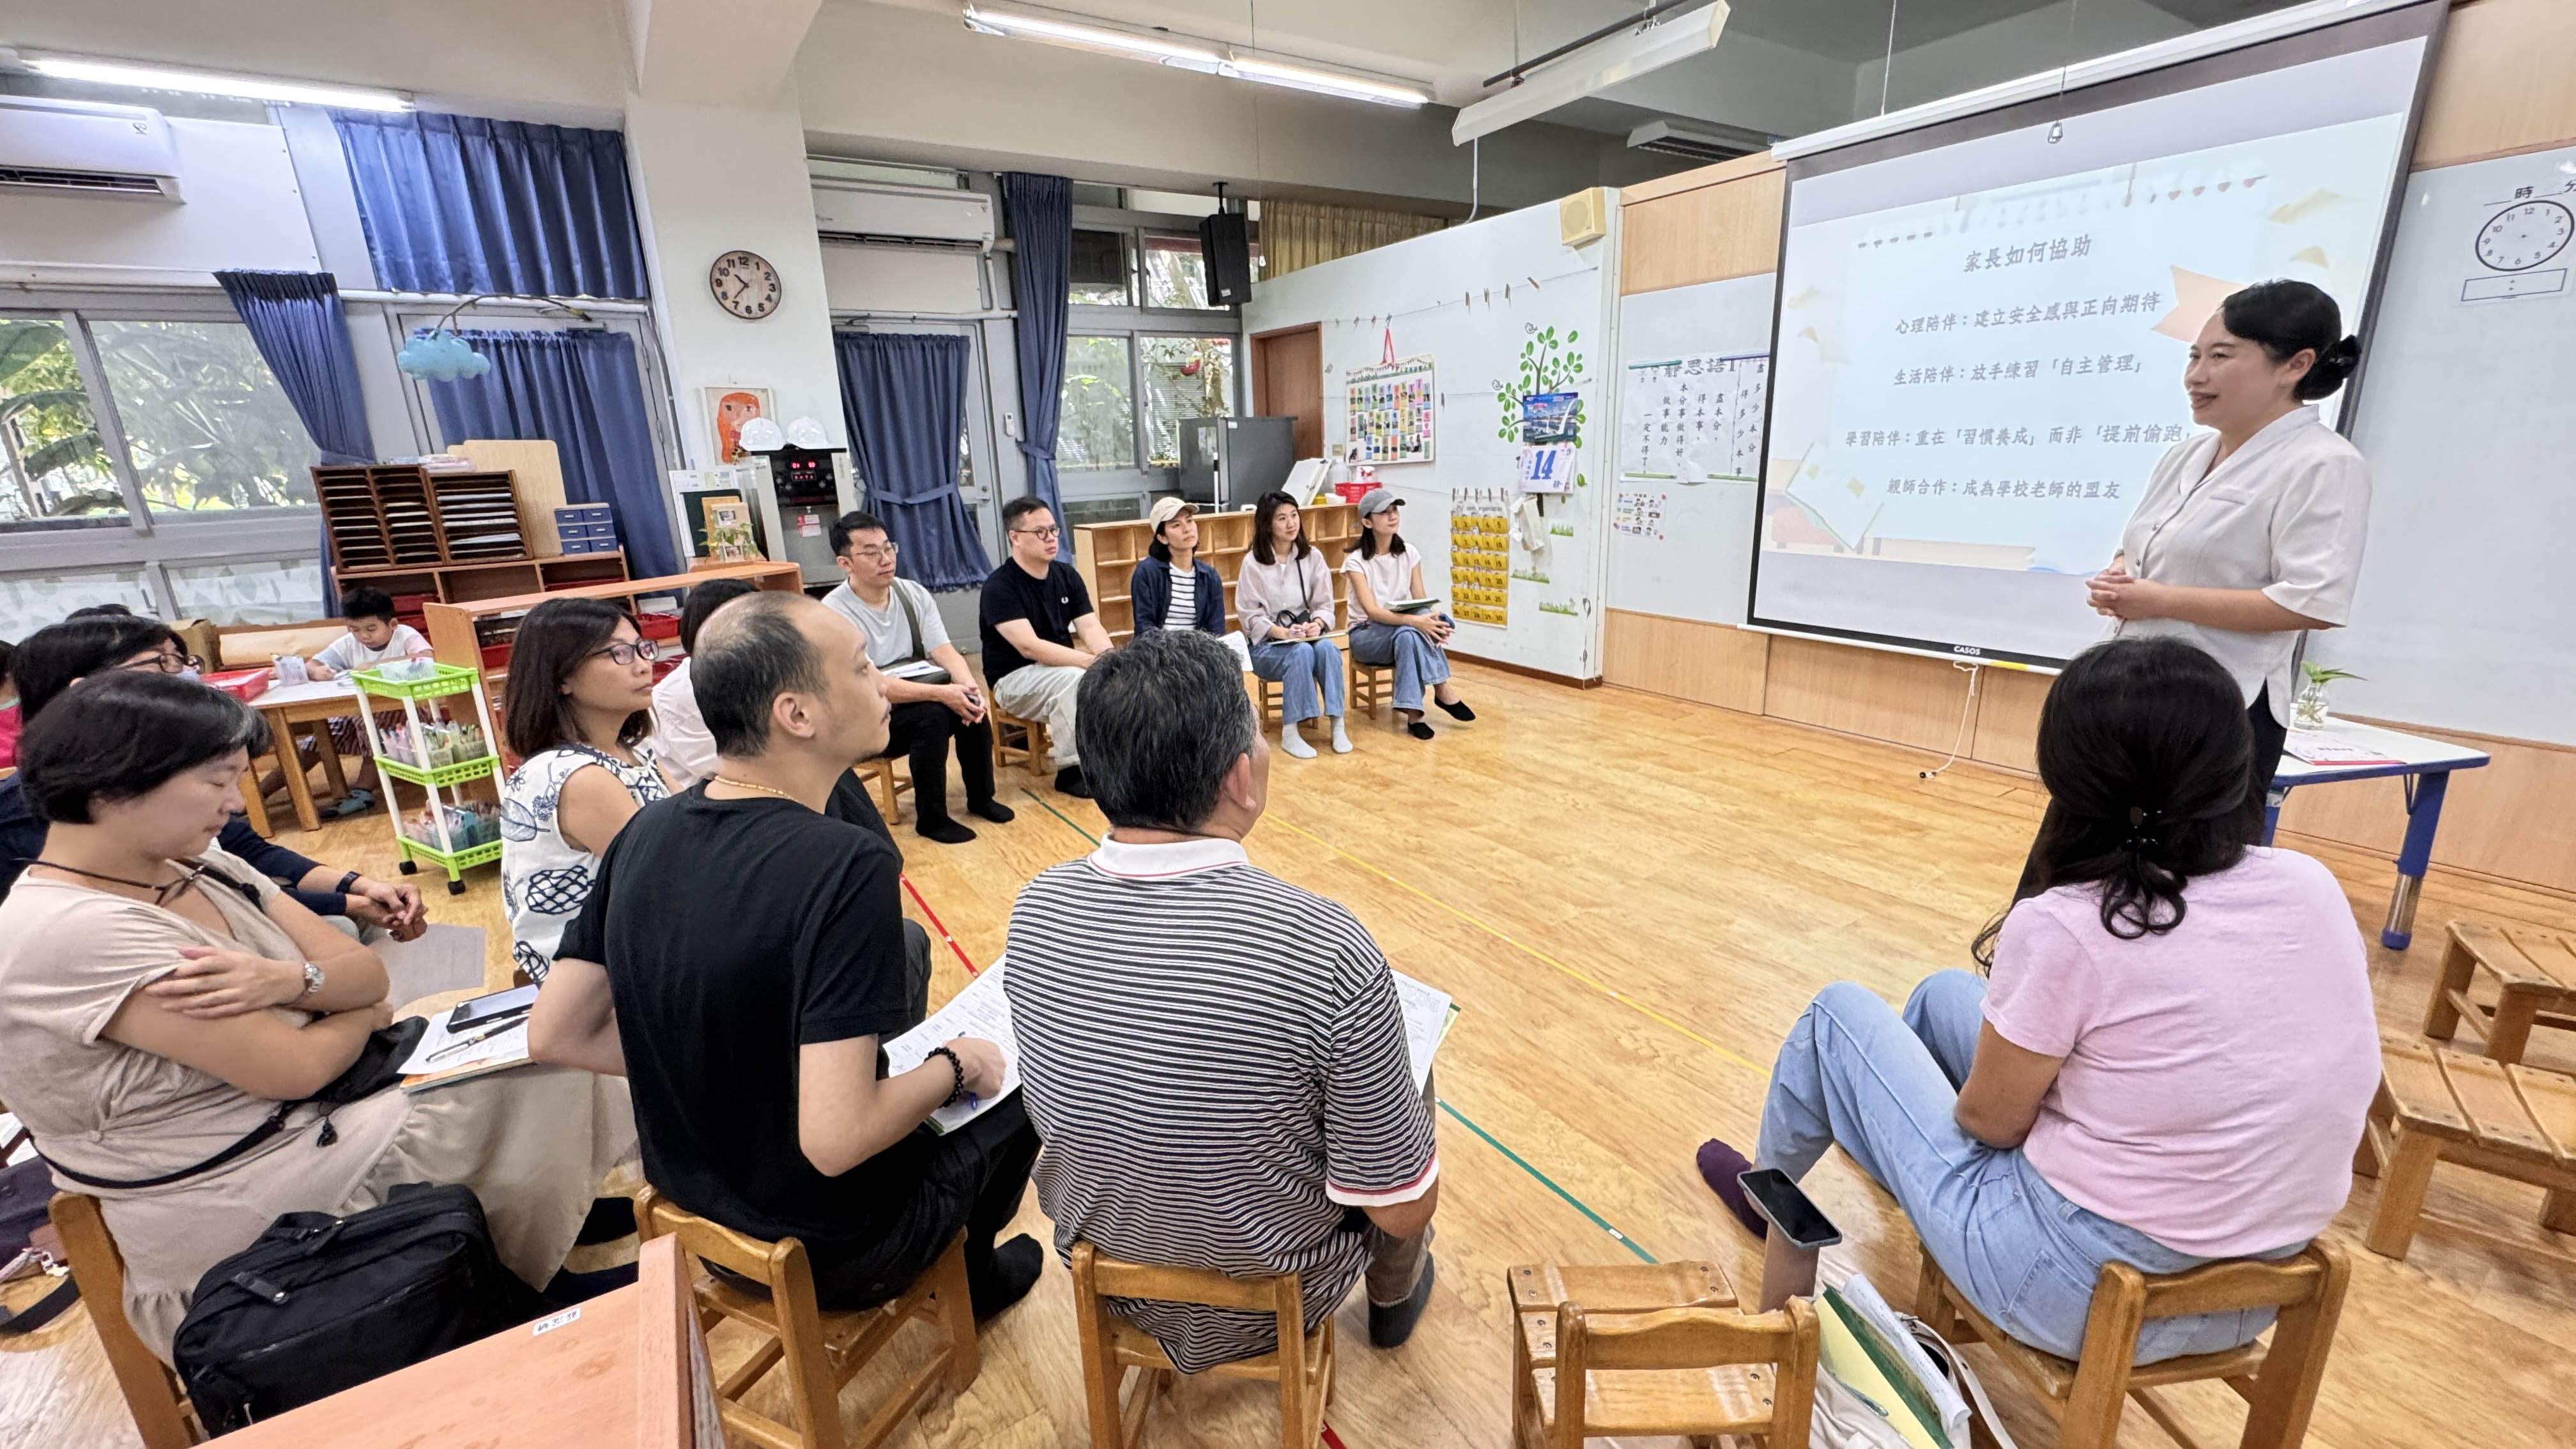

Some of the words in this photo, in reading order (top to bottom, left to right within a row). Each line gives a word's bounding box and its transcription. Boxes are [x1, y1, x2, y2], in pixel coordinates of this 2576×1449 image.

[2514, 186, 2534, 199] 時
[1964, 234, 2091, 273] 家長如何協助
[726, 259, 735, 268] 11
[737, 256, 749, 266] 12
[2497, 256, 2504, 264] 7
[755, 261, 760, 271] 1
[718, 267, 730, 277] 10
[764, 272, 771, 280] 2
[716, 279, 723, 288] 9
[769, 284, 776, 292] 3
[721, 291, 728, 300] 8
[765, 294, 772, 302] 4
[732, 300, 739, 310] 7
[746, 305, 752, 314] 6
[758, 303, 765, 312] 5
[1896, 291, 2161, 335] 心理陪伴：建立安全感與正向期待
[1894, 353, 2142, 385] 生活陪伴：放手練習「自主管理」
[1660, 395, 1671, 445] 做事能力
[1530, 450, 1557, 480] 14
[1887, 479, 2120, 499] 親師合作：成為學校老師的盟友
[1954, 645, 1981, 656] CASOS
